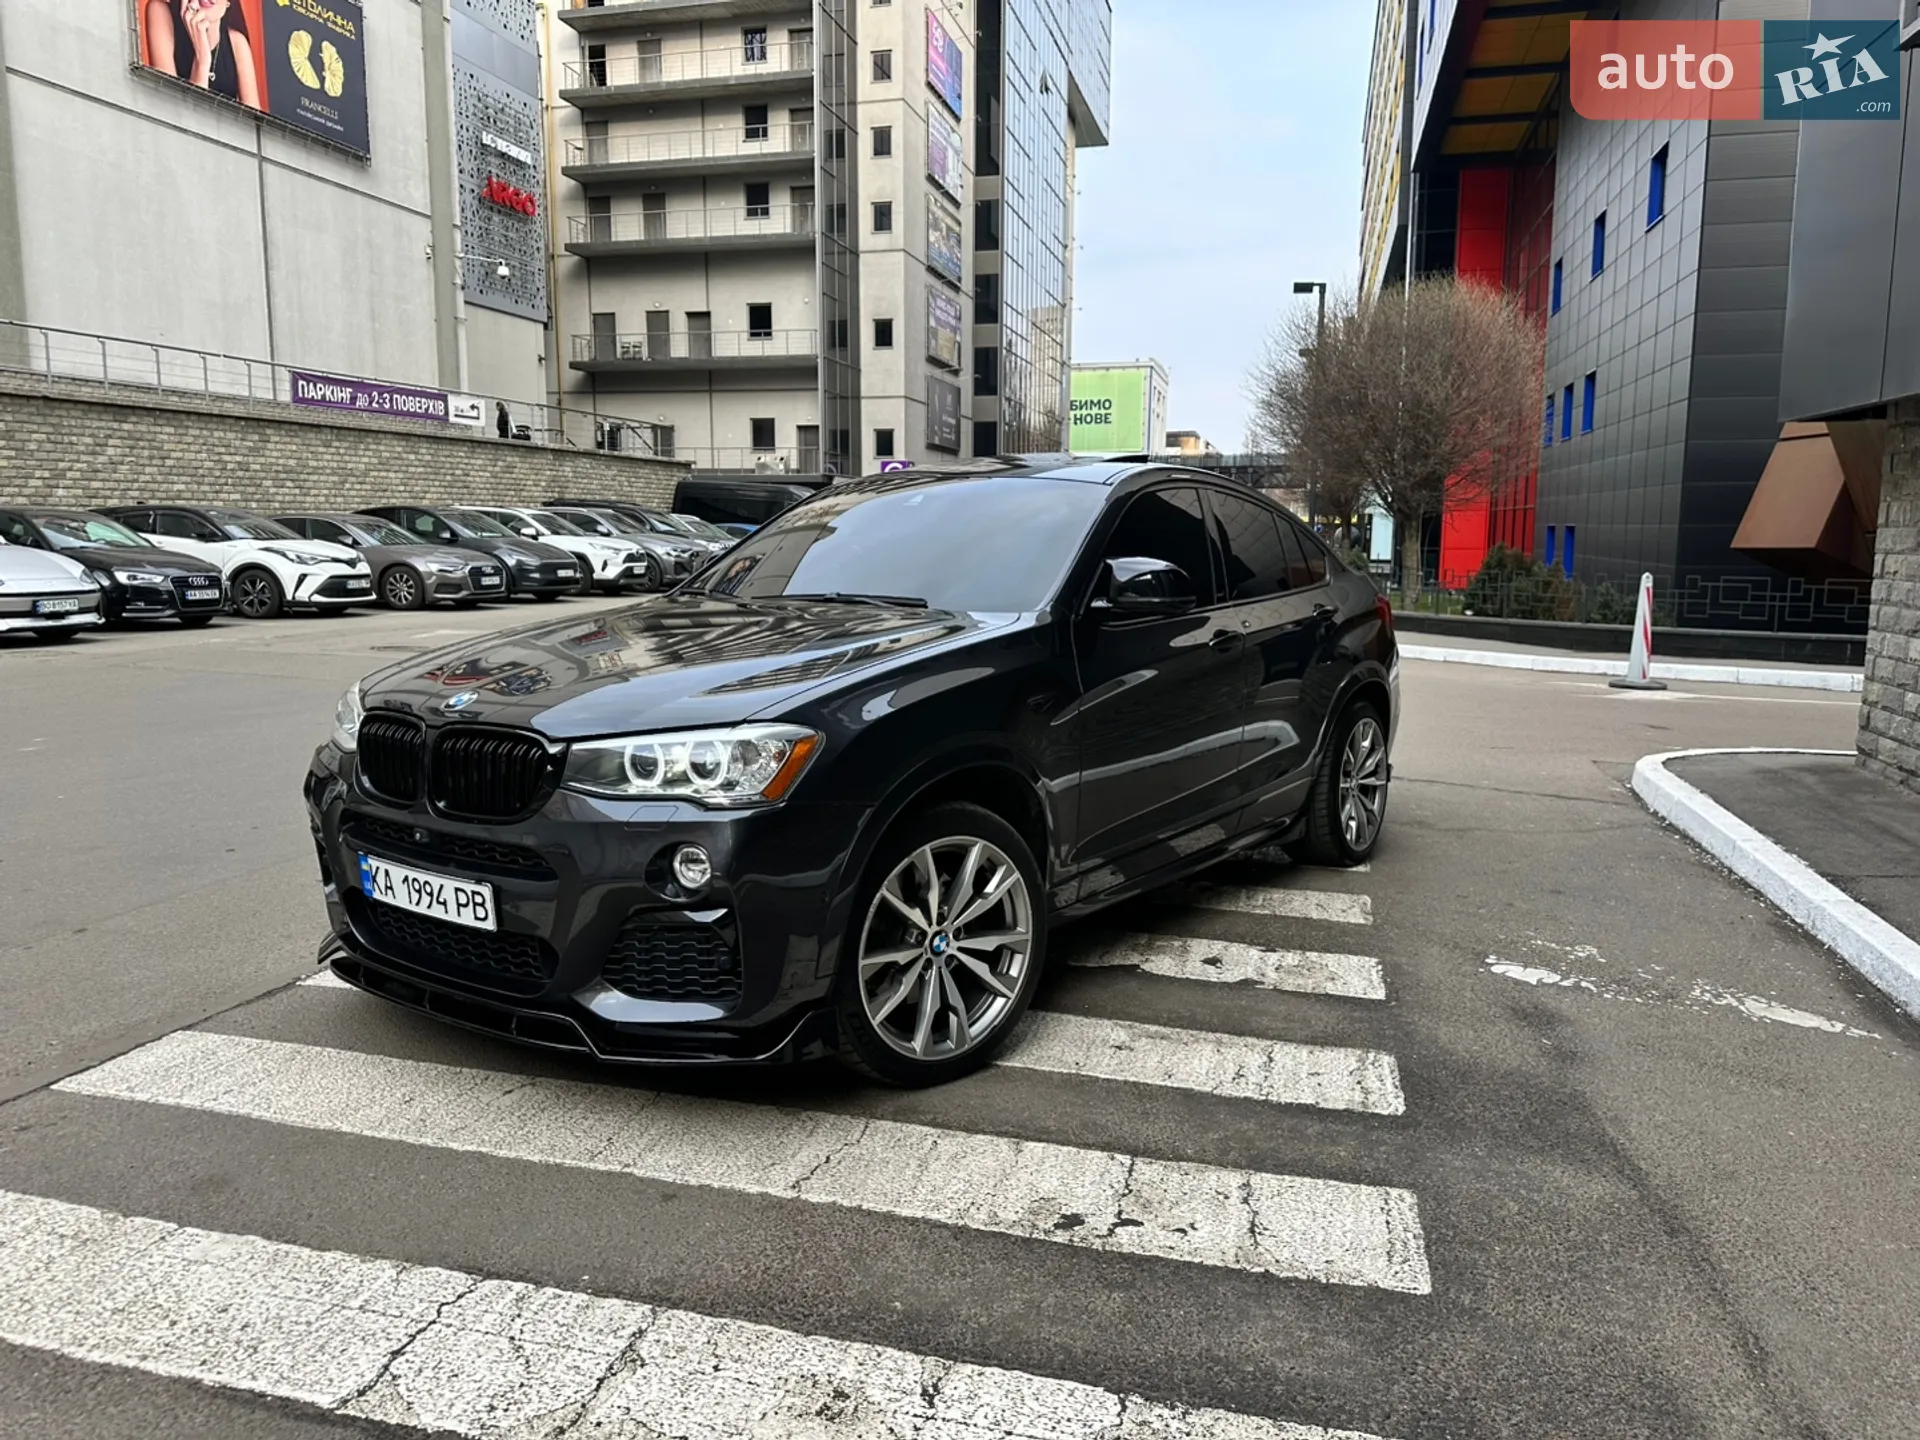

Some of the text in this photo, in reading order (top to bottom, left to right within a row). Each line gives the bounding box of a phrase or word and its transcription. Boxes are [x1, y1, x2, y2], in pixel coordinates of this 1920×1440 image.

[298, 379, 353, 404] ПАРКІНГ
[371, 391, 391, 409] 2-3
[393, 394, 445, 416] ПОВЕРХІВ
[1073, 412, 1112, 426] НОВЕ
[369, 863, 489, 922] KA 1994 PB
